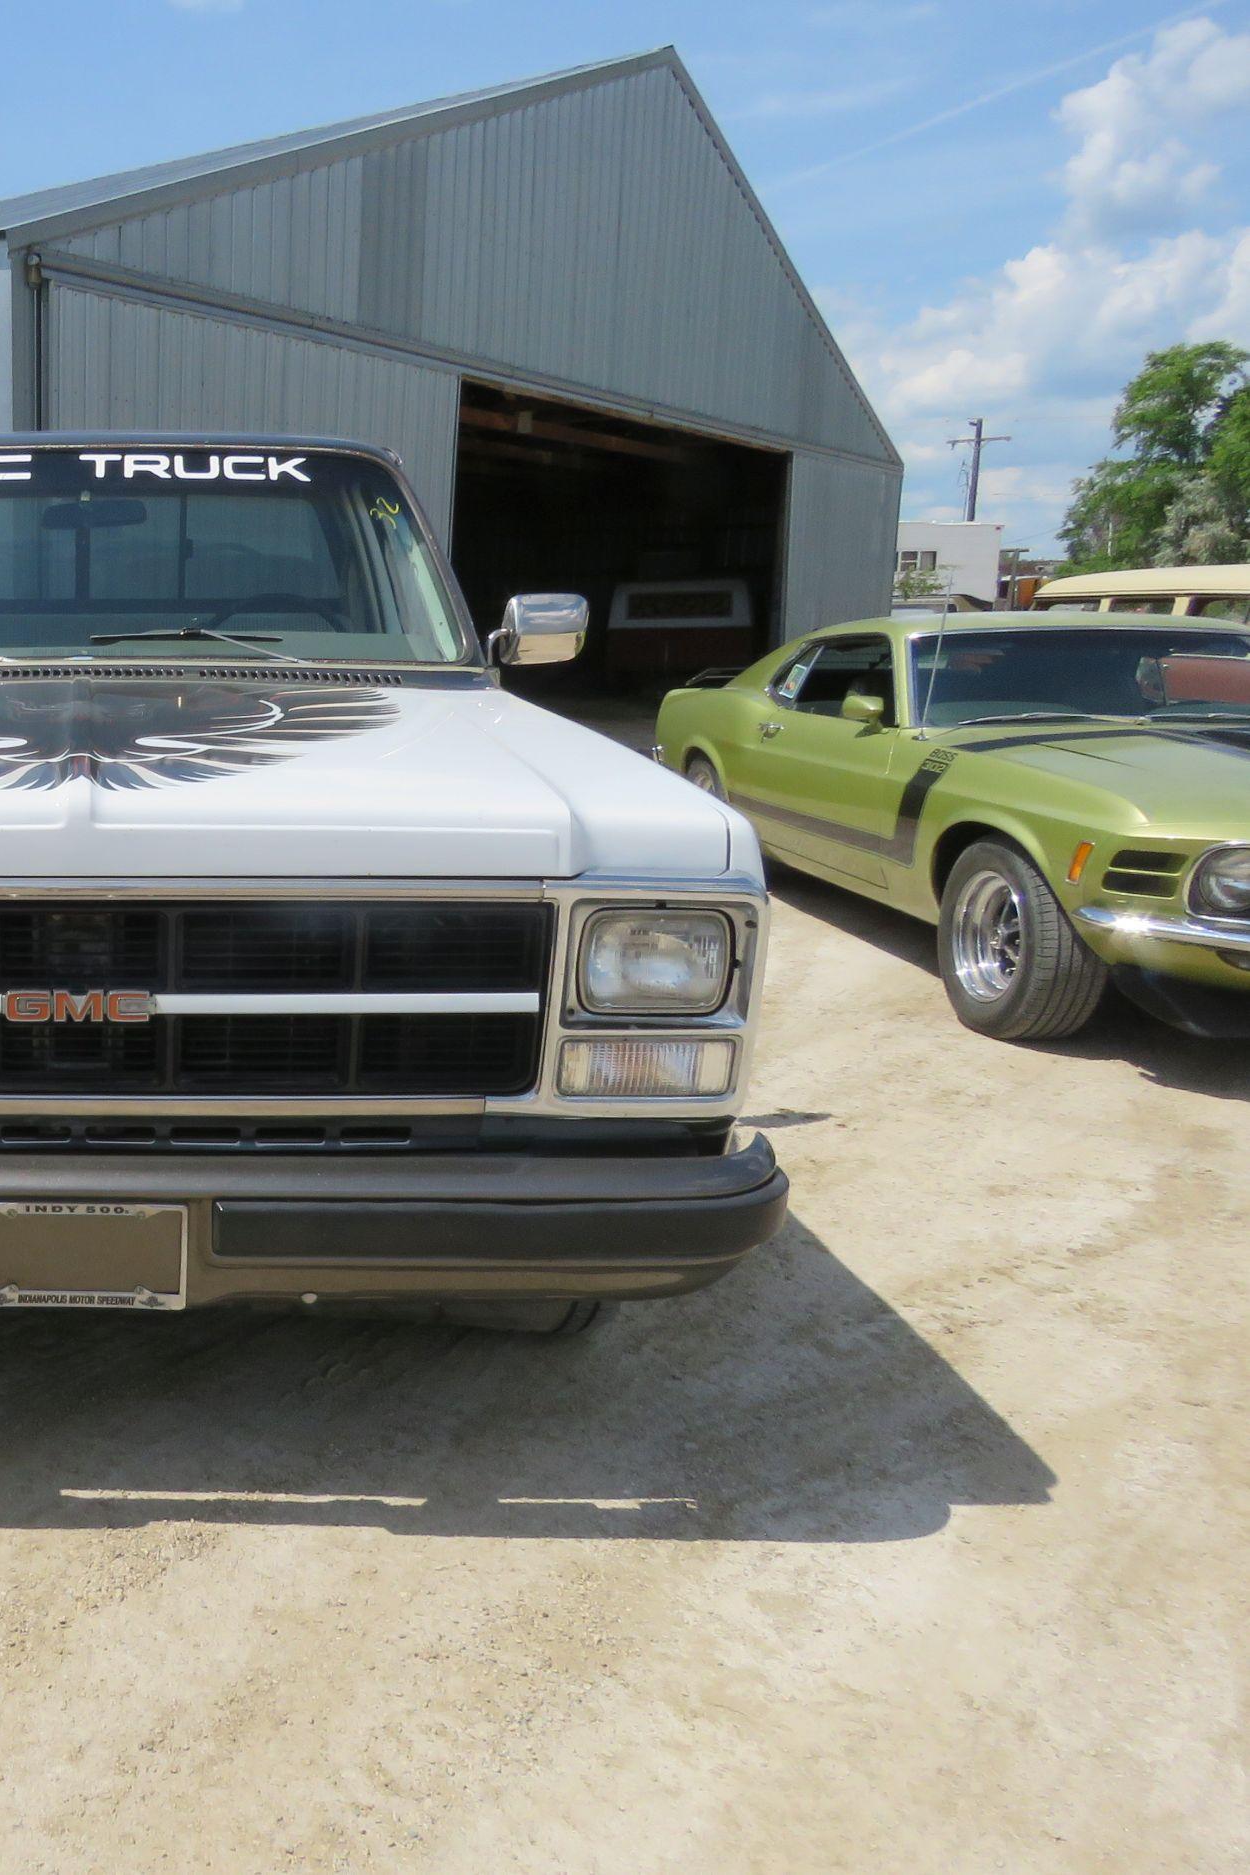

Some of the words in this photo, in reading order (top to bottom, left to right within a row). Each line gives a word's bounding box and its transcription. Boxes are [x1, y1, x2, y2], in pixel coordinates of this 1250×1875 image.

[79, 454, 312, 482] TRUCK
[929, 748, 958, 762] BOSS
[922, 759, 947, 773] 302
[4, 989, 151, 1023] GMC
[25, 1205, 78, 1213] INDY
[18, 1294, 68, 1305] INDIANAPOLIS
[69, 1295, 96, 1305] MOTOR
[97, 1295, 136, 1306] SPEEDWAY
